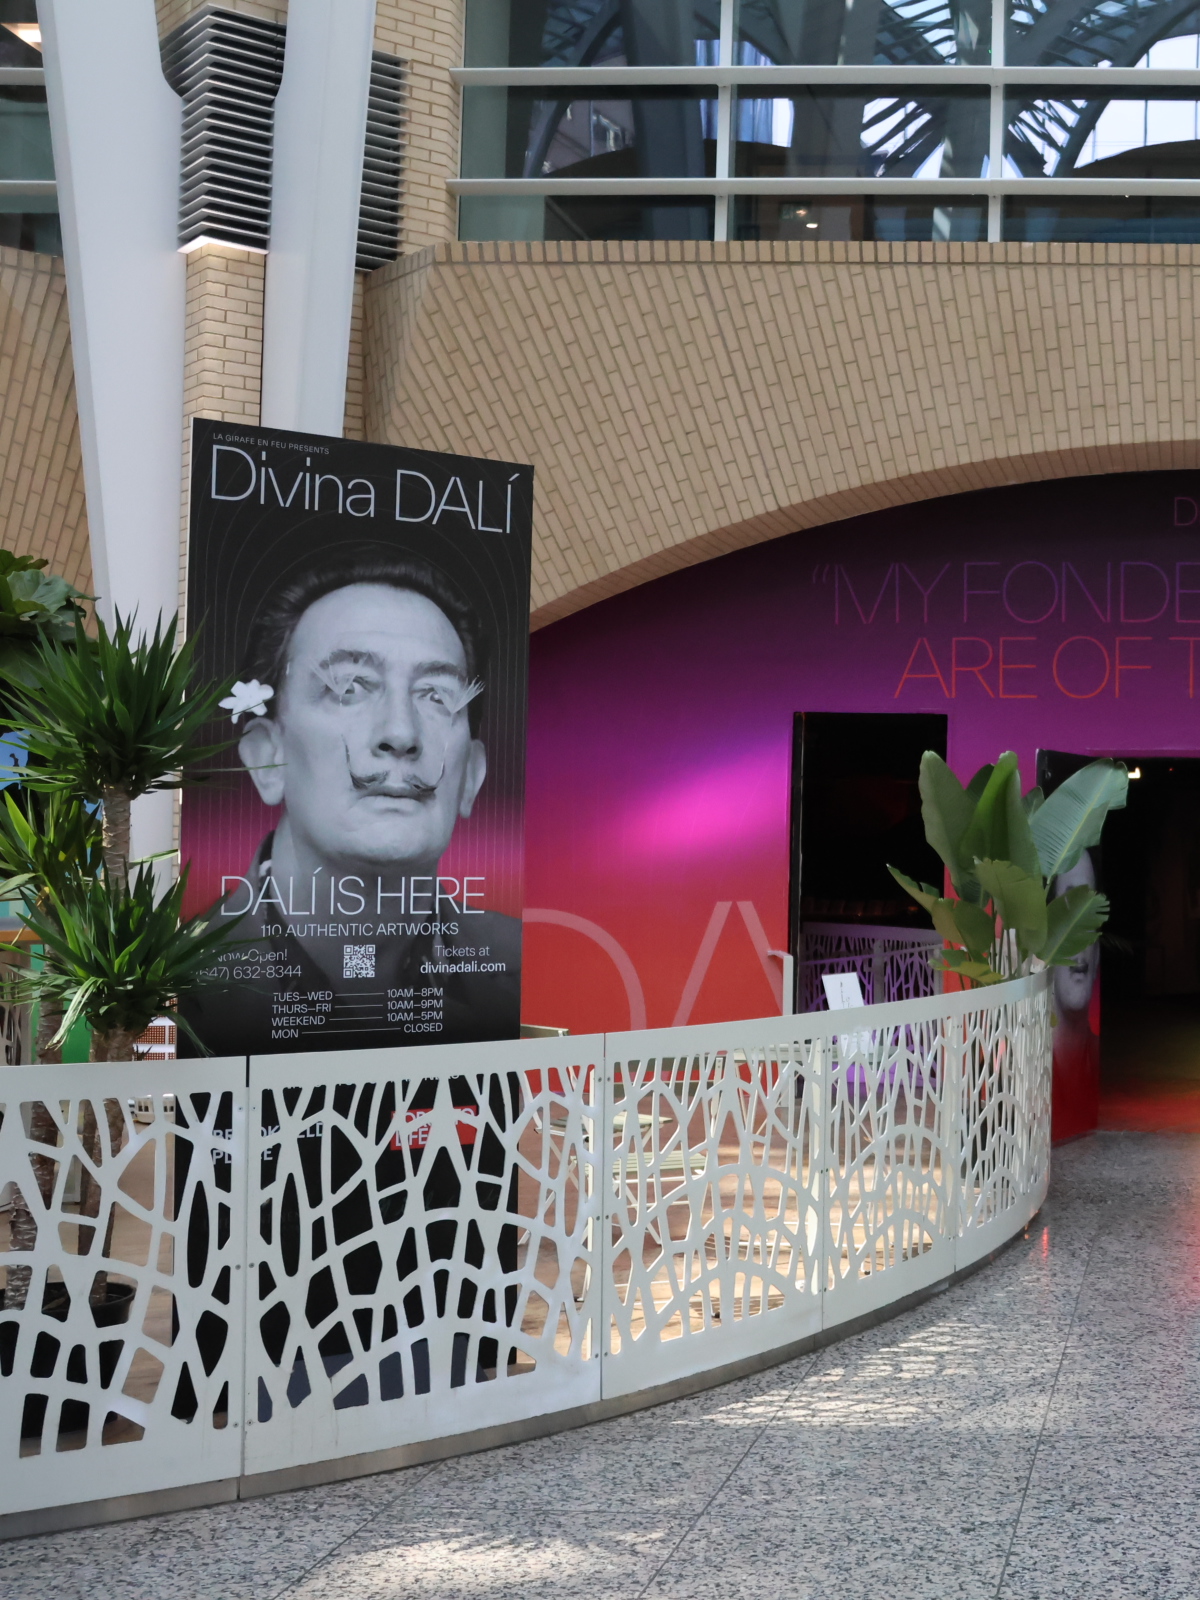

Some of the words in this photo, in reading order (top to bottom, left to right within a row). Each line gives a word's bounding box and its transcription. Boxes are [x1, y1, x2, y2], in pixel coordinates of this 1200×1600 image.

[225, 434, 255, 445] GIRAFE
[271, 441, 287, 449] FEU
[288, 443, 330, 455] PRESENTS
[211, 444, 376, 518] Divina
[395, 468, 520, 534] DALÍ
[893, 636, 1038, 699] ARE
[1052, 635, 1152, 699] OF
[220, 866, 323, 916] DALÍ
[330, 875, 366, 916] IS
[376, 876, 485, 915] HERE
[261, 924, 282, 938] 110
[286, 923, 373, 938] AUTHENTIC
[376, 922, 459, 936] ARTWORKS
[248, 949, 288, 964] Open!
[435, 945, 476, 957] Tickets
[478, 946, 490, 957] at
[233, 965, 302, 979] 632-8344
[420, 960, 506, 974] divinadali.com
[271, 1016, 326, 1027] WEEKEND
[271, 1029, 299, 1039] MON
[403, 1022, 443, 1033] CLOSED
